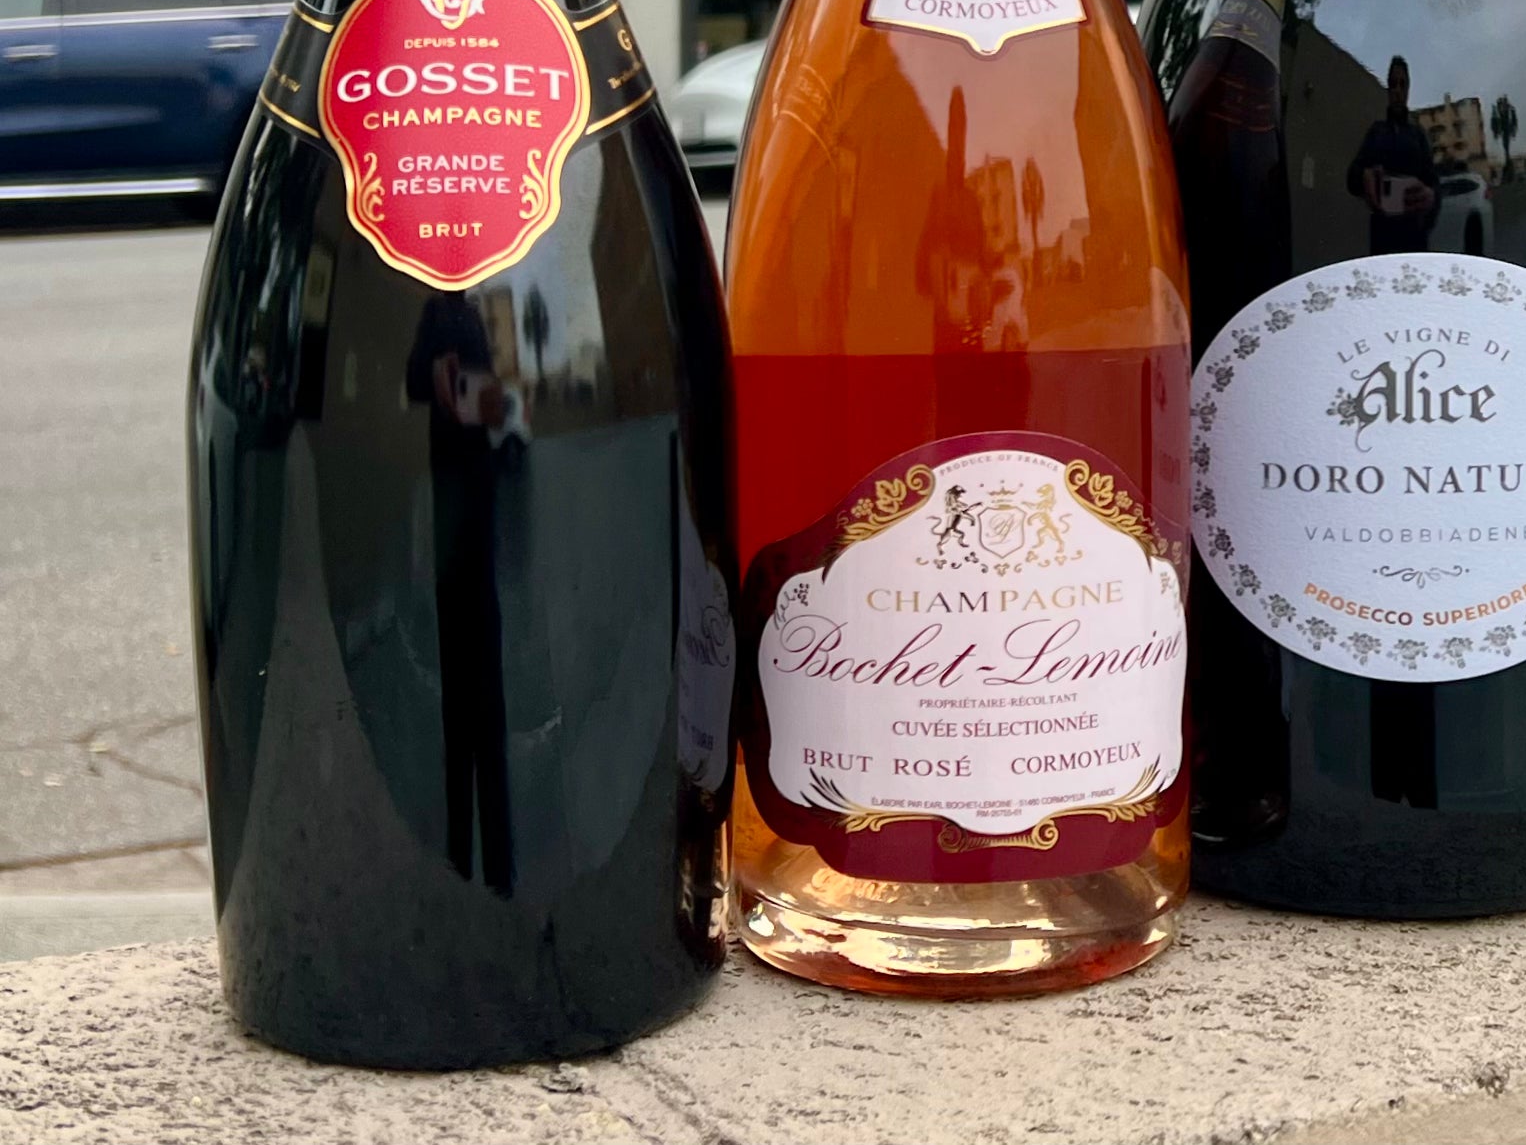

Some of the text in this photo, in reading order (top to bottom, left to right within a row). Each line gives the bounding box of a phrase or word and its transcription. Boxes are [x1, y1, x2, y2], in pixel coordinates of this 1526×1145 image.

[404, 37, 456, 50] DEPUIS
[336, 62, 569, 104] GOSSET
[363, 107, 542, 130] CHAMPAGNE
[398, 155, 505, 173] GRANDE
[392, 175, 511, 196] RÉSERVE
[419, 223, 483, 239] BRUT
[1337, 327, 1511, 364] LE VIGNE DI
[1350, 349, 1497, 453] Alice
[1261, 461, 1385, 495] DORO
[866, 579, 1124, 614] CHAMPAGNE
[1303, 582, 1413, 627] PROSECCO
[892, 713, 1099, 738] CUVÉE SÉLECTIONNÉE
[803, 748, 972, 777] BRUT ROSÉ
[1010, 741, 1142, 776] CORMOYEUX
